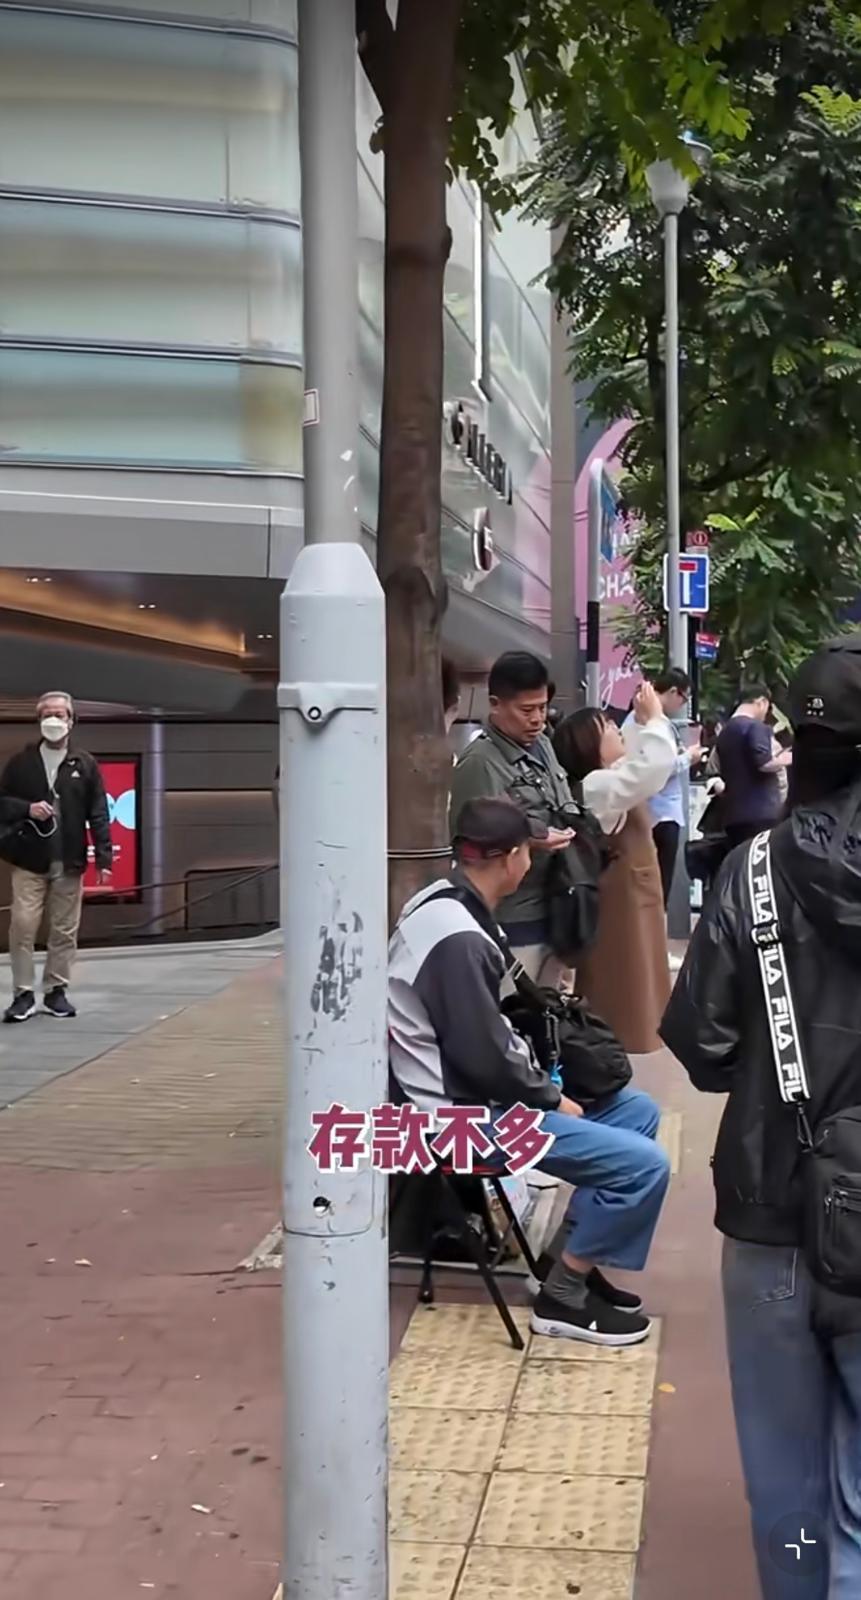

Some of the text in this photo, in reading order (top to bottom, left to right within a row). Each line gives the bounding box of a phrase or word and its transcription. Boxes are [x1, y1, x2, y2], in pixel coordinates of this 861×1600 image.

[753, 874, 773, 923] FILA
[771, 996, 794, 1051] FILA
[782, 1062, 803, 1102] FIL
